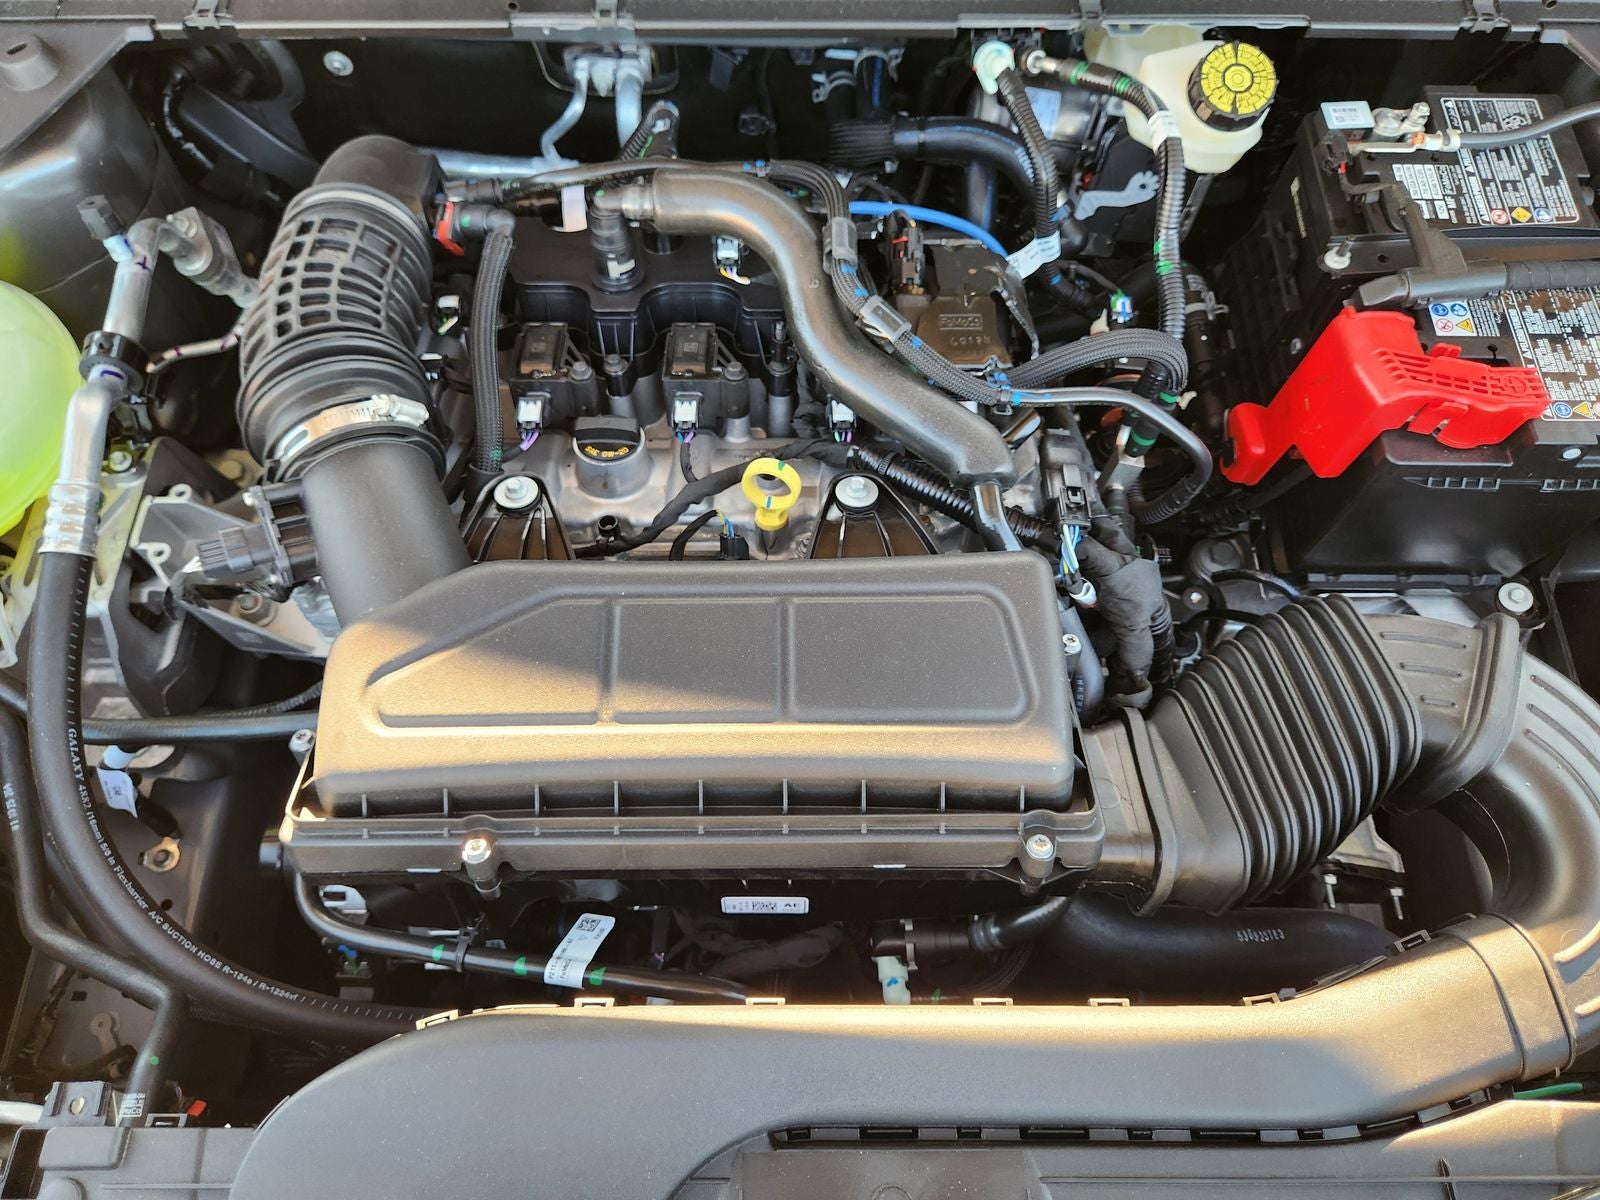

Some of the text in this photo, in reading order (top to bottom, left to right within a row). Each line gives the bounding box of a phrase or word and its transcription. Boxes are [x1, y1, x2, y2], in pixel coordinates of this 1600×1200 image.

[1439, 166, 1452, 193] FoMoCo
[585, 446, 629, 457] SAE 0W-20
[68, 728, 84, 781] GALAXY
[79, 784, 91, 809] 4882
[148, 910, 163, 925] A/C
[162, 922, 198, 953] SUCTION
[197, 950, 223, 970] HOSE
